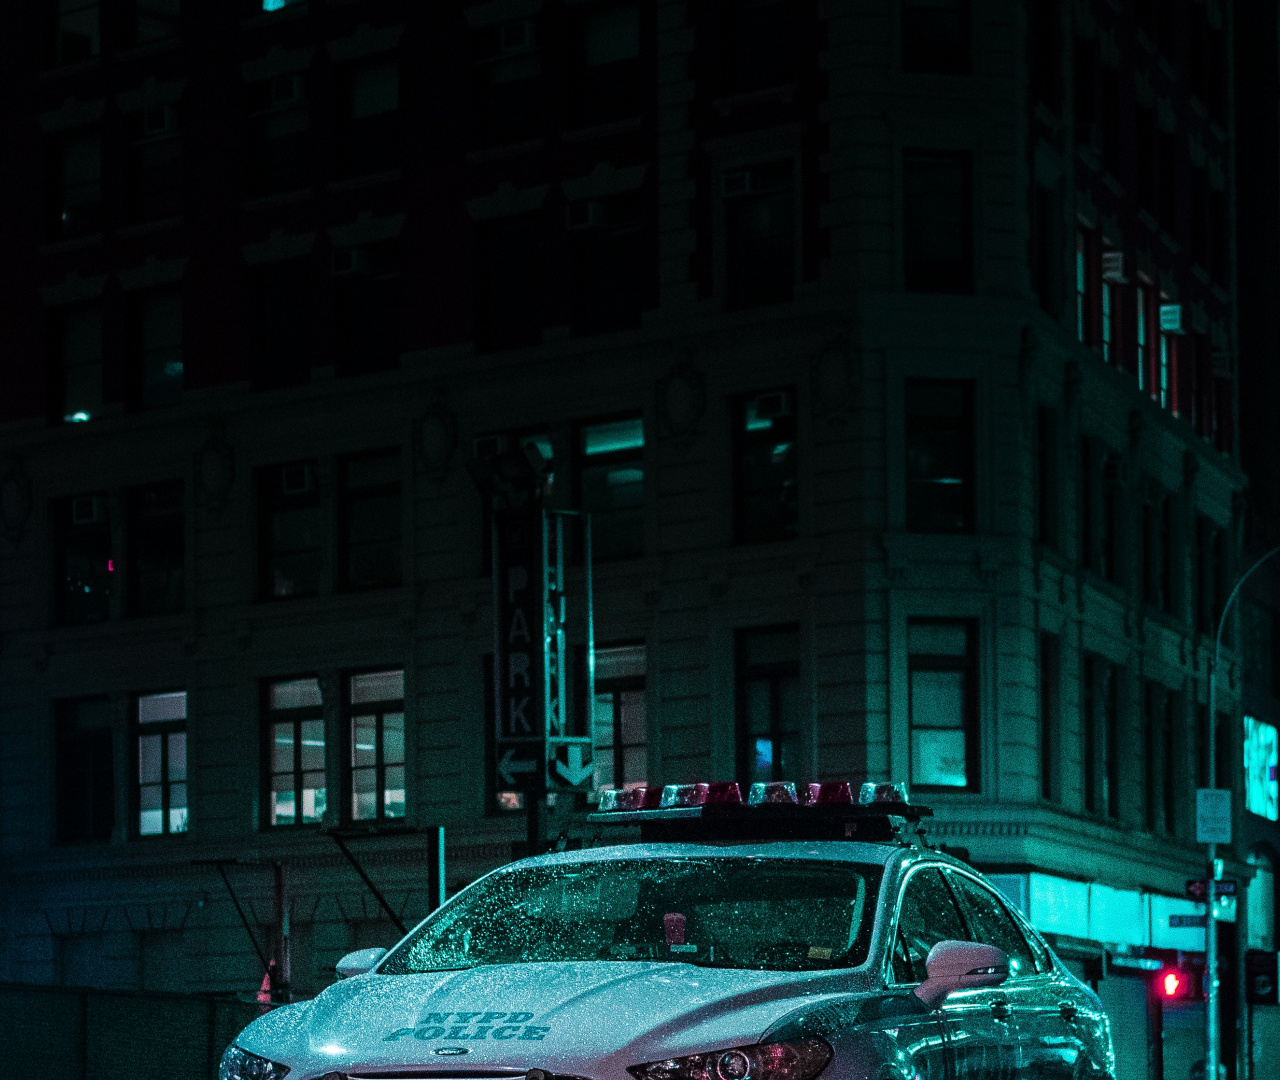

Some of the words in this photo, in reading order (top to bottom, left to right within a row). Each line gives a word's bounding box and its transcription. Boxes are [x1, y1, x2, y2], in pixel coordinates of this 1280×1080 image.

[508, 567, 531, 733] PARK
[420, 1011, 535, 1024] NYPD
[382, 1025, 551, 1042] POLICE
